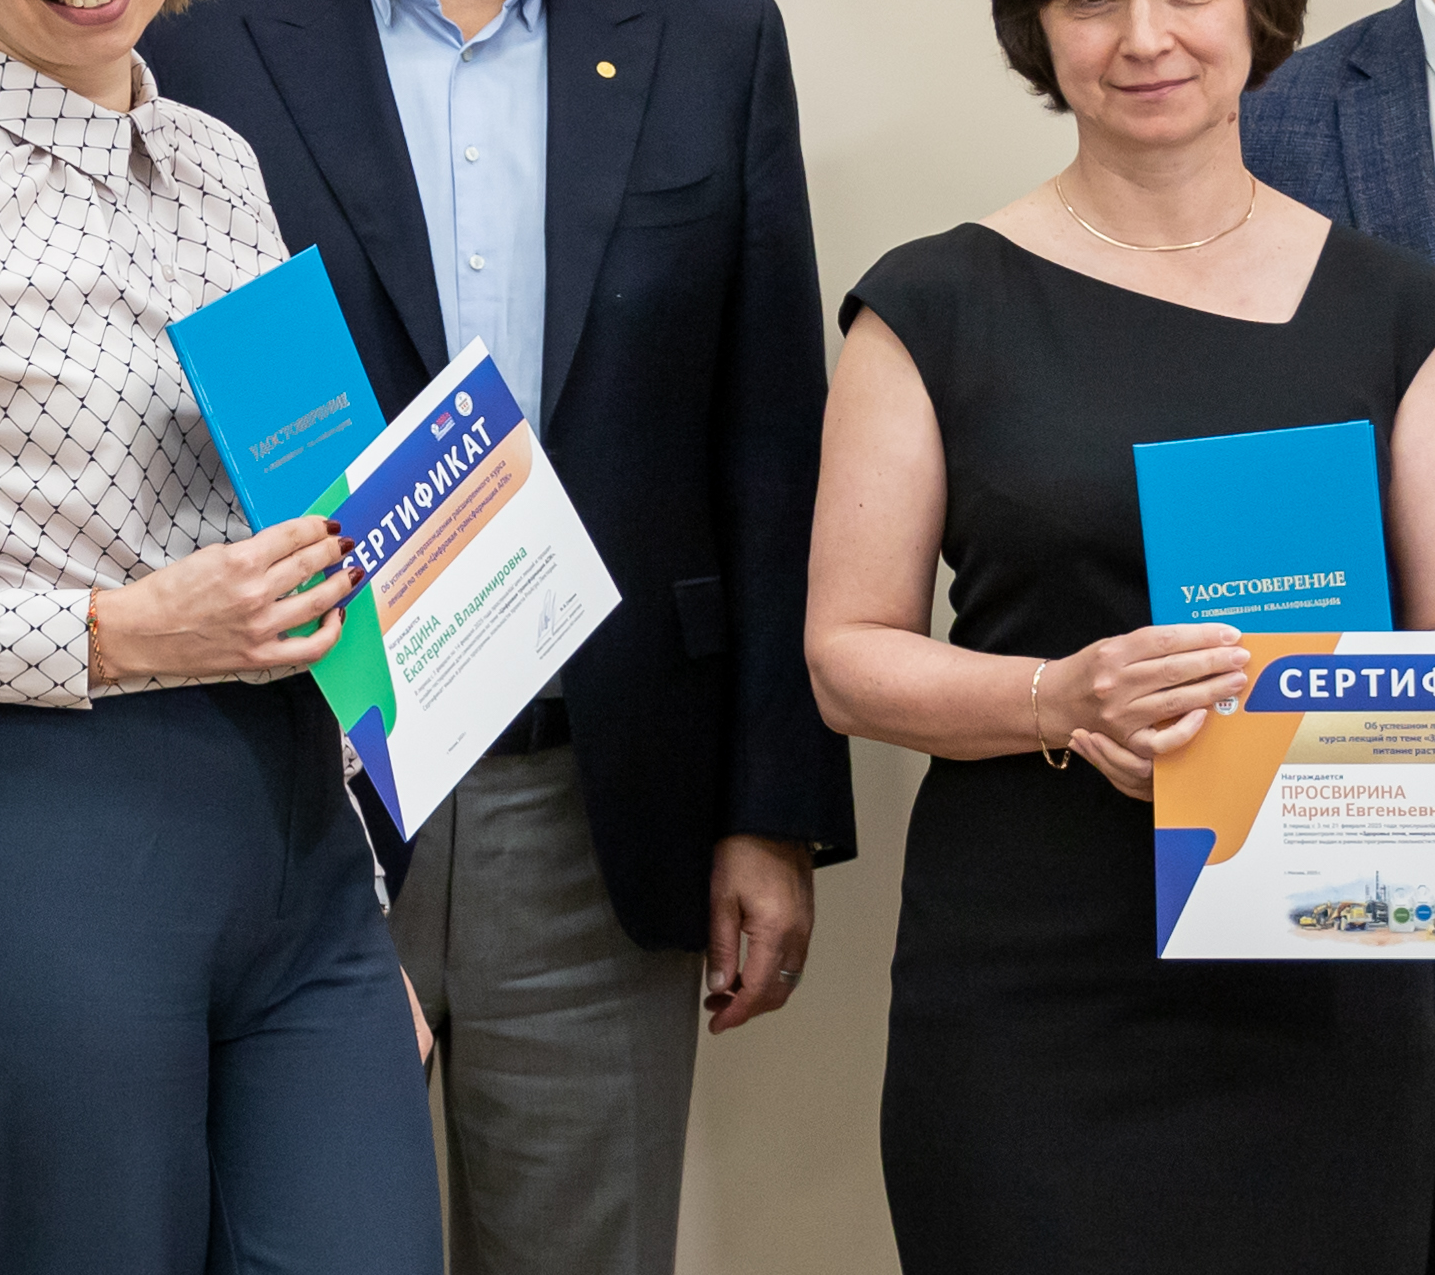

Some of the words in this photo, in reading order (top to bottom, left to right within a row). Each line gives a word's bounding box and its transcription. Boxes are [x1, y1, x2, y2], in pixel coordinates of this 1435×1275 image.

[1180, 571, 1347, 604] УДОСТОВЕРЕНИЕ
[402, 623, 458, 684] Екатерина
[452, 546, 529, 628] Владимировна
[395, 614, 442, 666] ФАДИНА
[1280, 773, 1345, 782] Награждается
[1281, 784, 1407, 801] ПРОСВИРИНА
[1281, 802, 1341, 822] Мария
